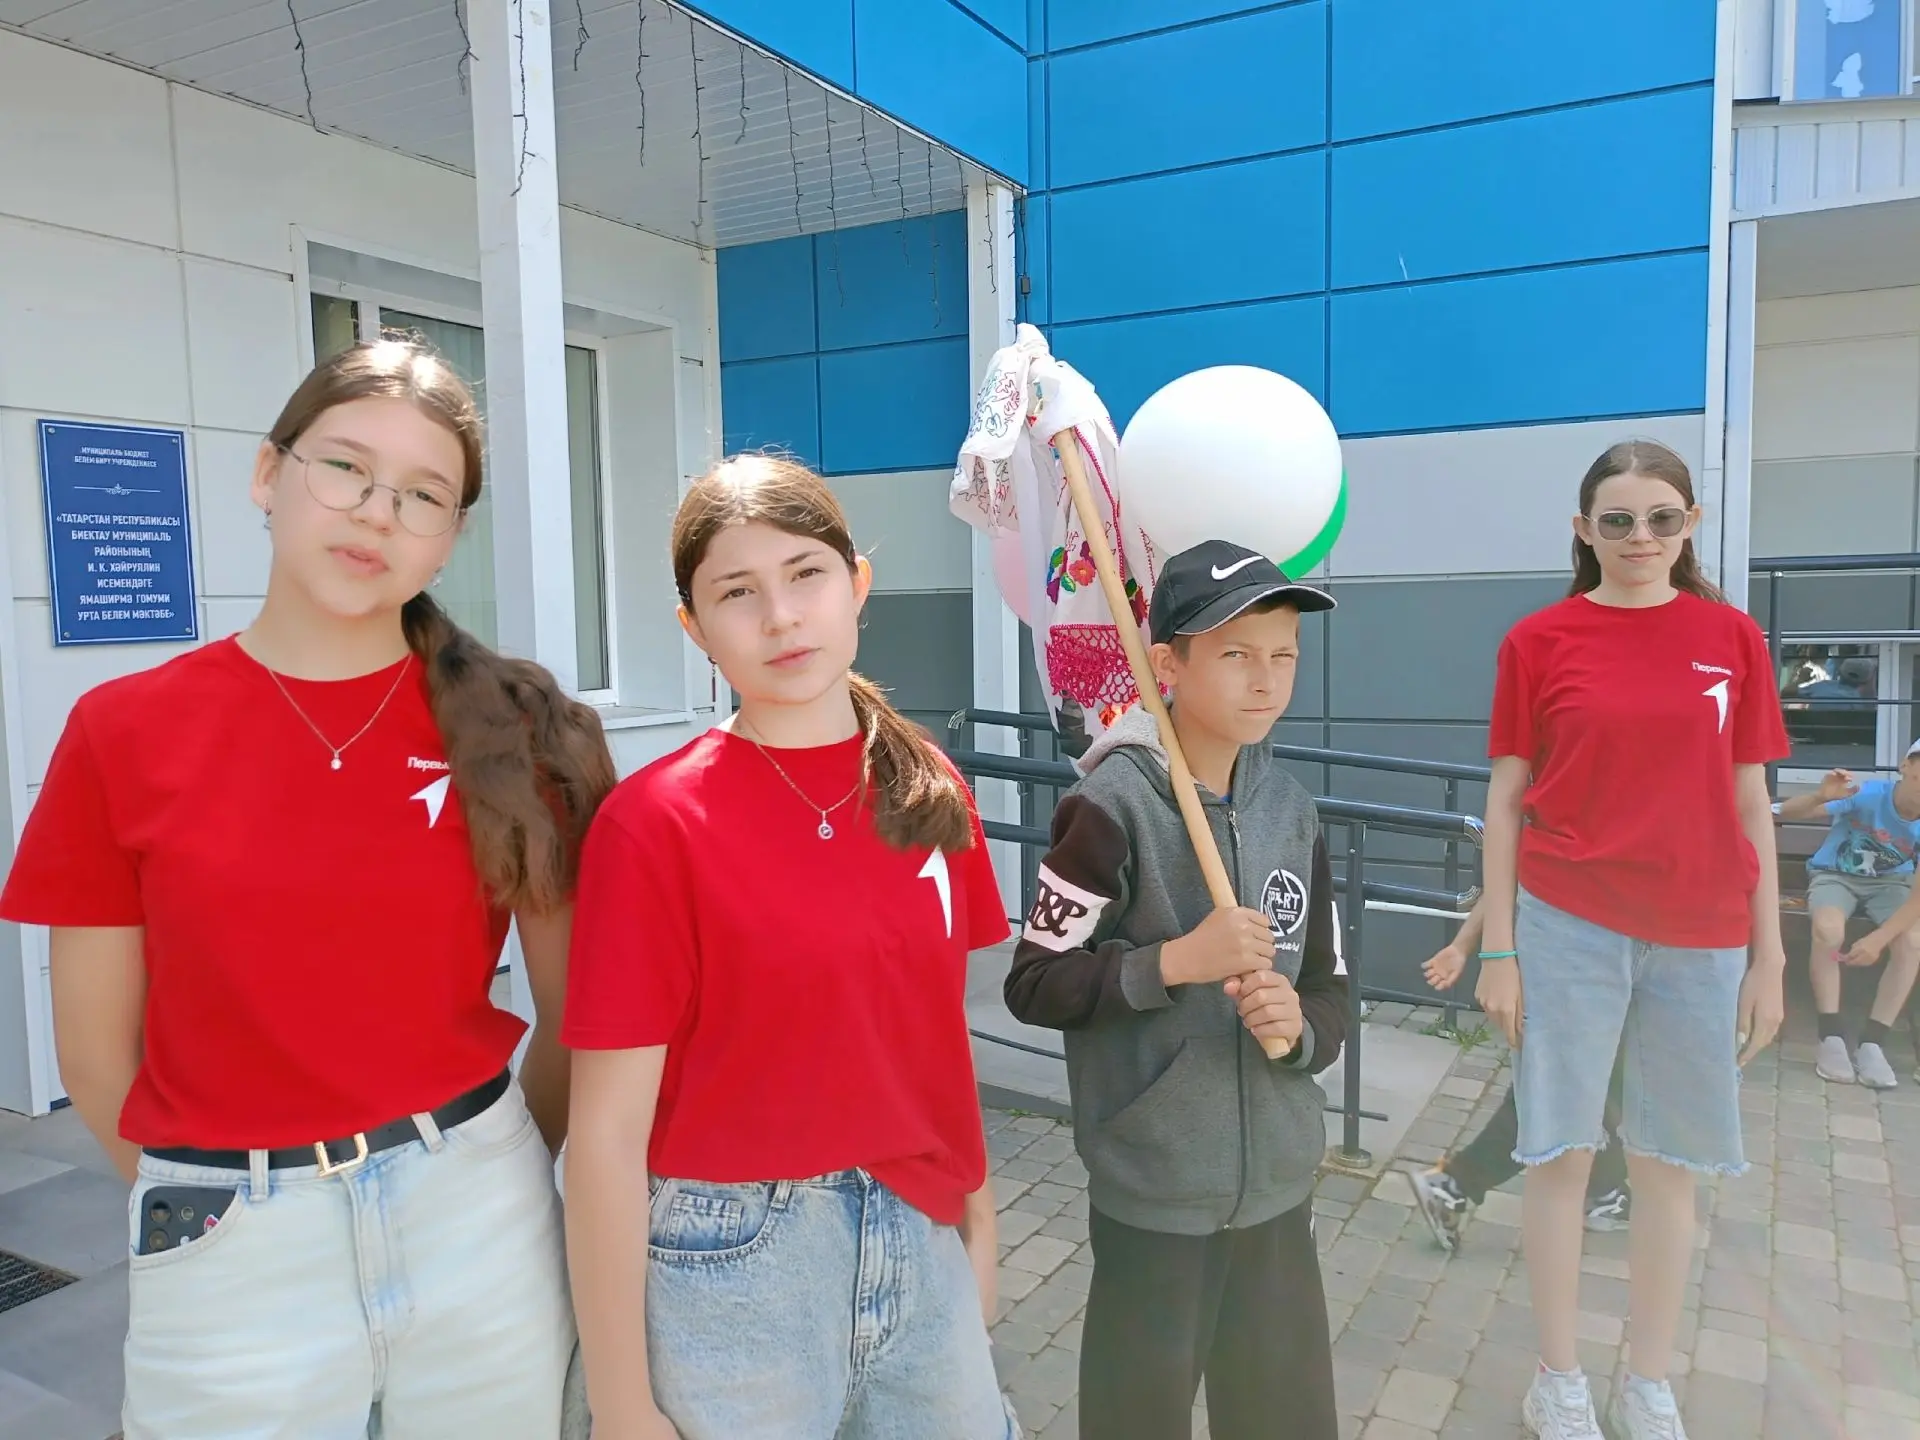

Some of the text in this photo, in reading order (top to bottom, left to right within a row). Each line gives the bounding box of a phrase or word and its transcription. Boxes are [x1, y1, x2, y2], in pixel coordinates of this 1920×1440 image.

[81, 447, 150, 458] МУНИЦИПАЛЬ БЮДЖЕТ
[56, 513, 181, 526] «ТАТАРСТАН РЕСПУБЛИКАСЫ
[71, 530, 172, 542] БИЕКТАУ МУНИЦИПАЛЬ
[94, 545, 152, 558] РАЙОНЫНЫҢ
[88, 562, 161, 573] И. К. ХӘЙРУЛЛИН
[97, 578, 153, 589] ИСЕМЕНДӘГЕ
[80, 593, 170, 605] ЯМАШИРМӘ ГОМУМИ
[77, 608, 175, 621] УРТА БЕЛЕМ МӘКТӘБЕ»
[1277, 912, 1296, 922] BOYS
